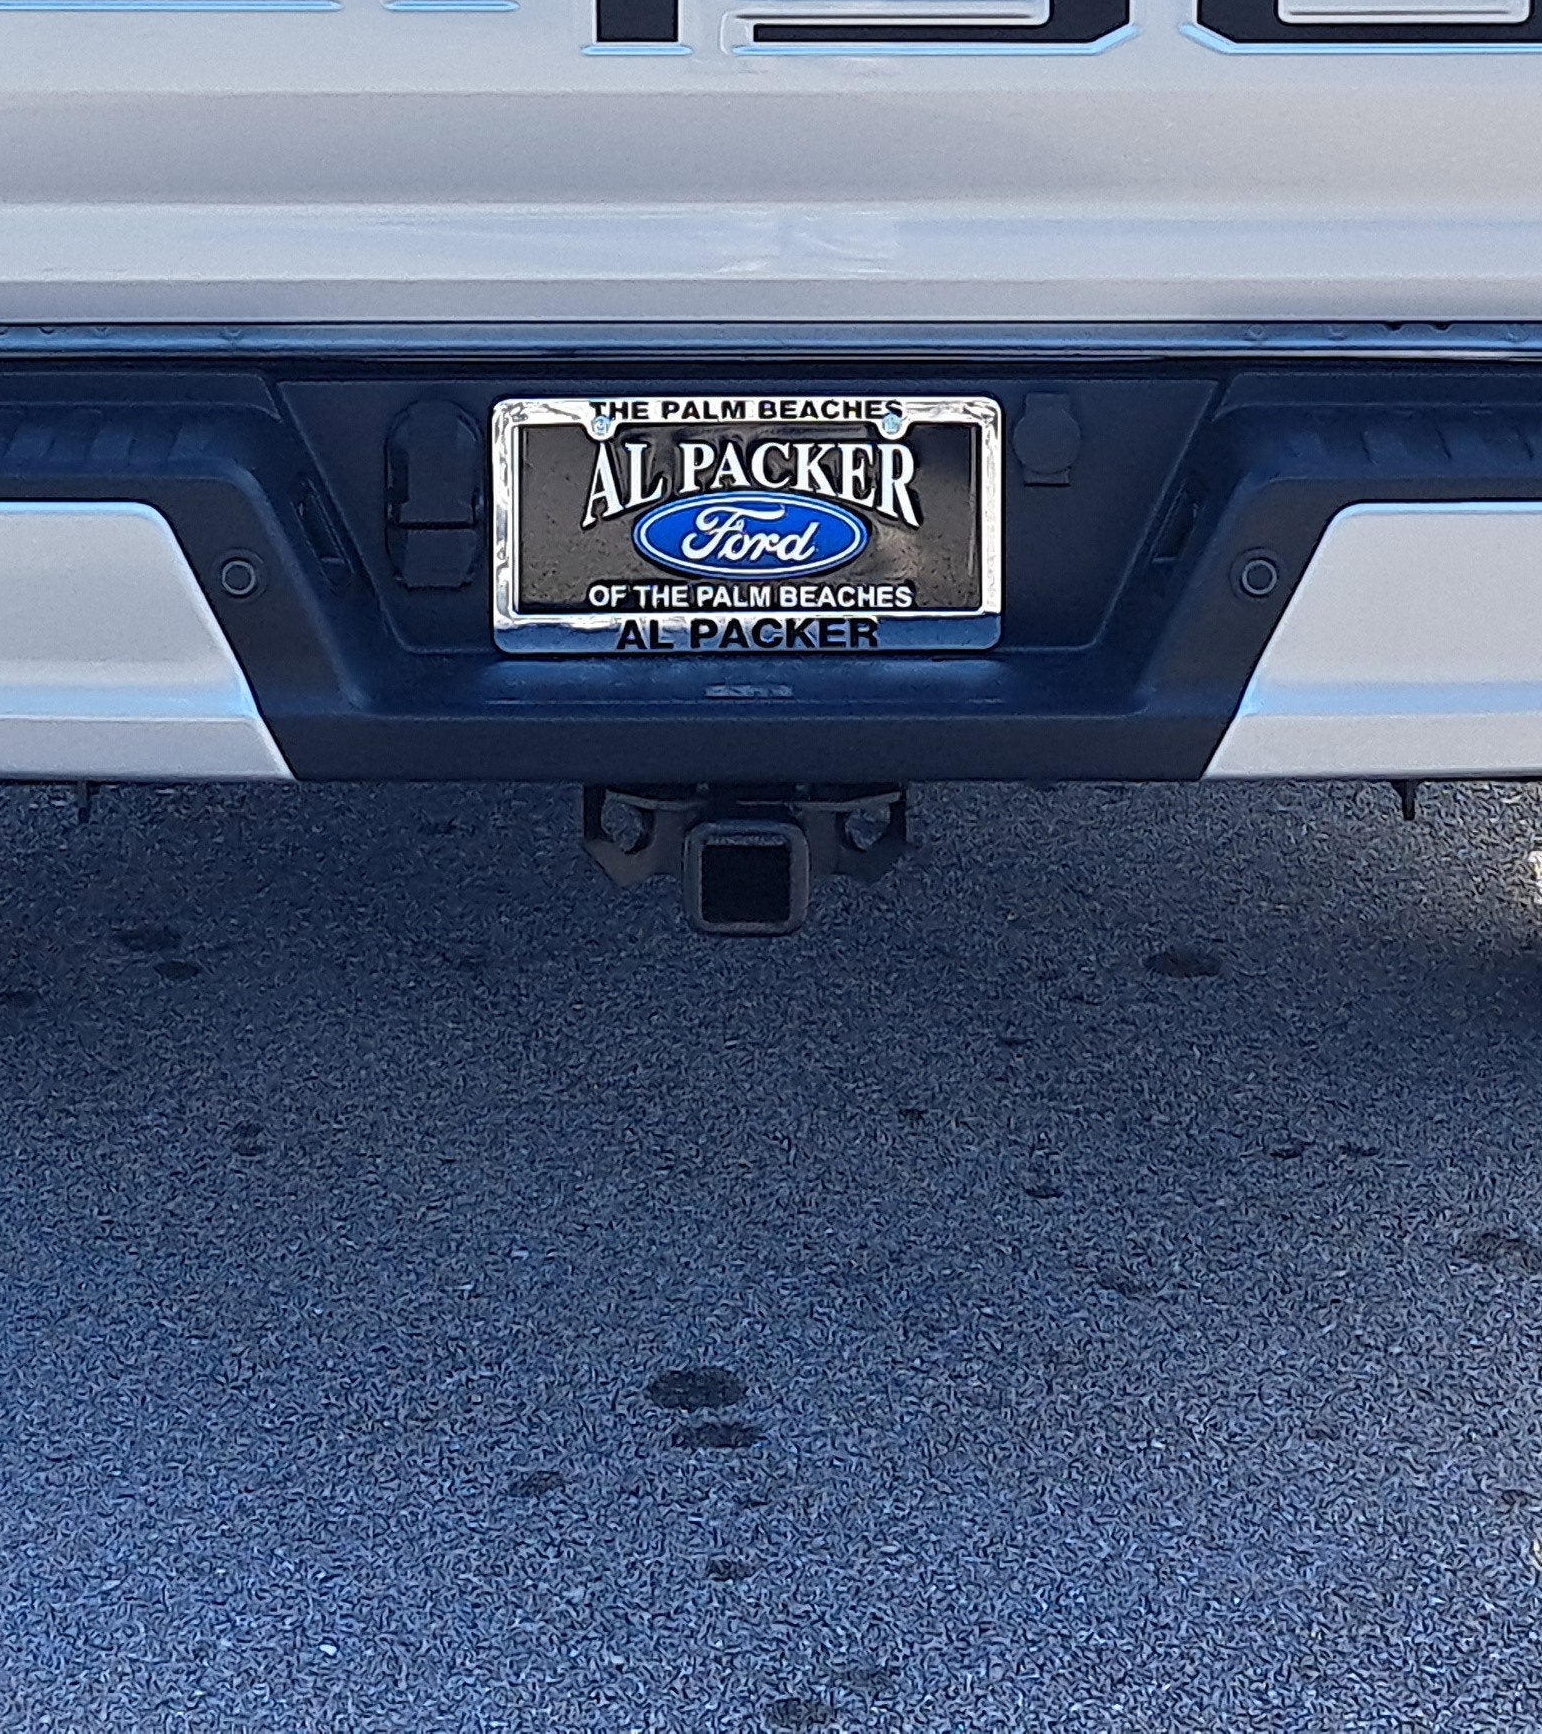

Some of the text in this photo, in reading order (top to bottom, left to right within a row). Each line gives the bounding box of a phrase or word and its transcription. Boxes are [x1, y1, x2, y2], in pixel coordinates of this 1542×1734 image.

[590, 399, 903, 420] THE PALM BEACHES
[581, 441, 920, 528] AL PACKER
[681, 506, 817, 561] Ford
[588, 584, 913, 609] OF THE PALM BEACHES
[615, 617, 880, 650] AL PACKER
